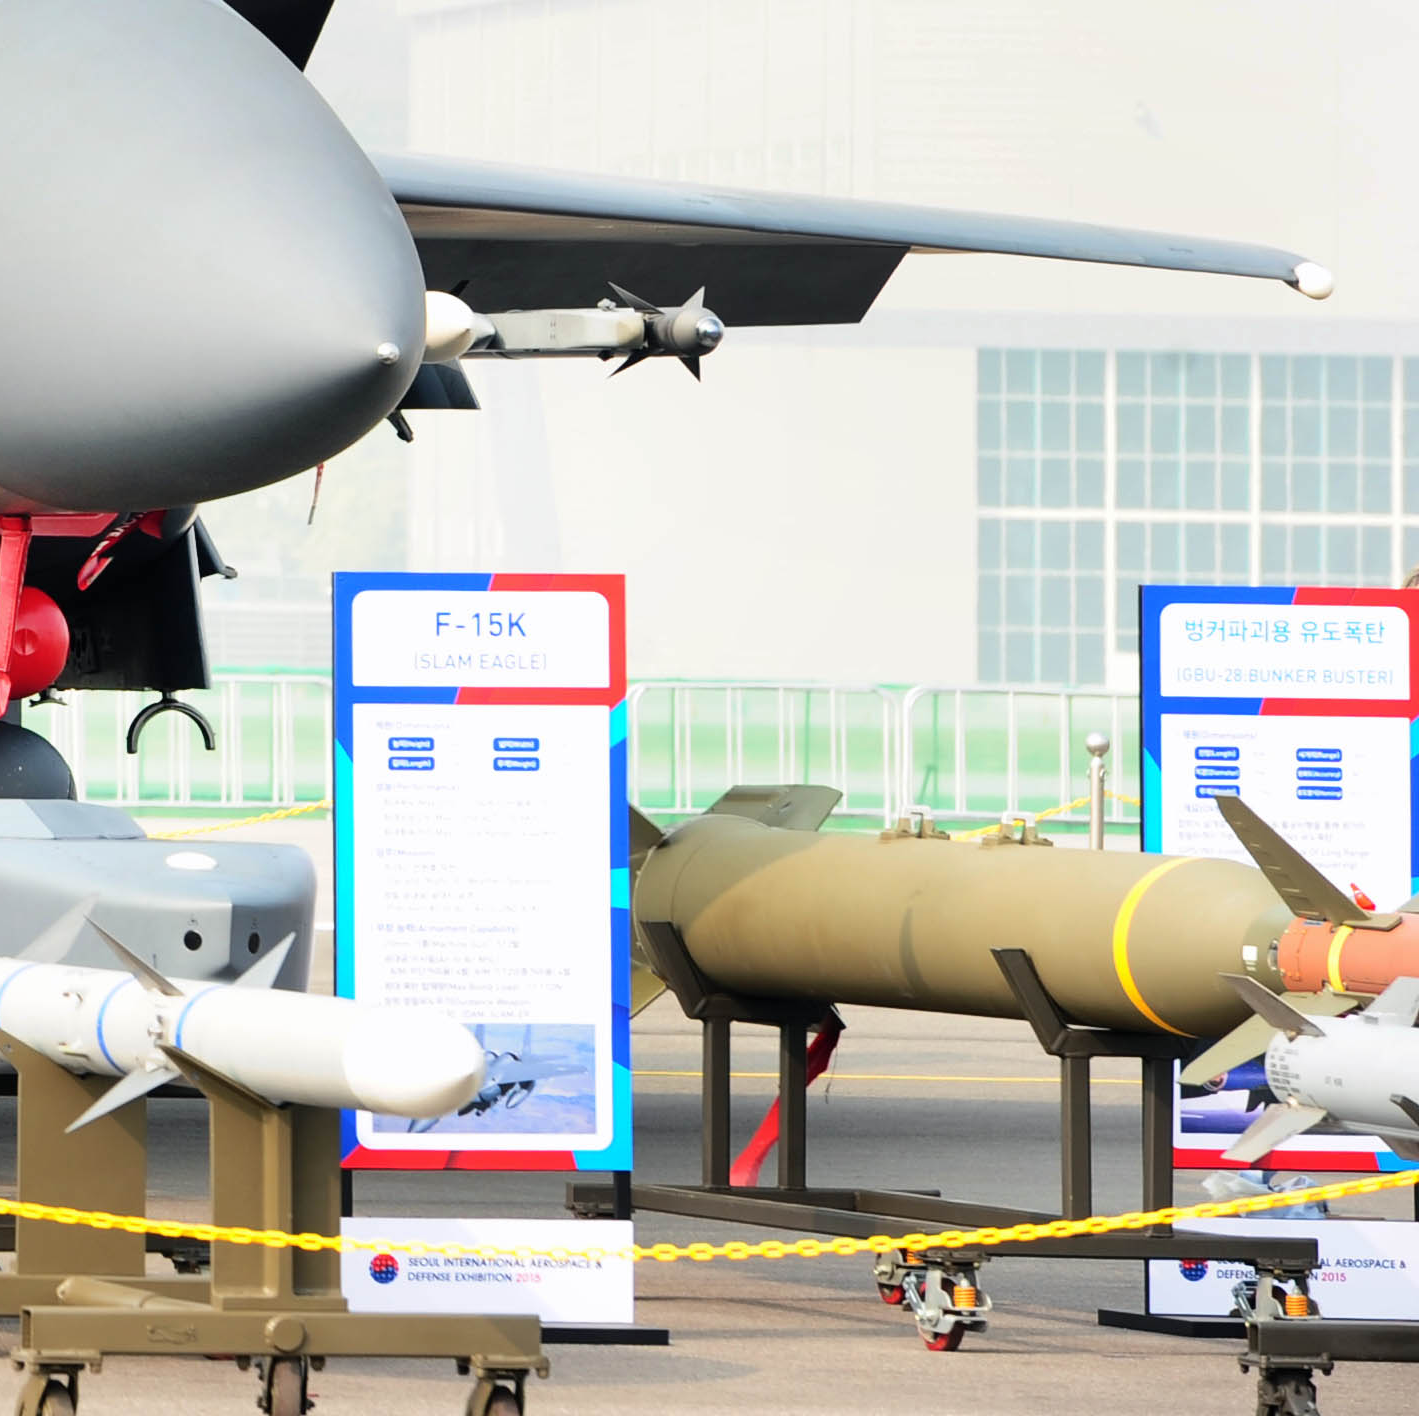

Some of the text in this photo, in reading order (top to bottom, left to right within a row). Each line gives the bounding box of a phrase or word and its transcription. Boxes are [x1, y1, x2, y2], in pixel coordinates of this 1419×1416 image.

[435, 612, 527, 637] F-15K
[1185, 619, 1385, 644] 벙커파괴용 유도폭탄
[414, 653, 548, 672] (SLAM EAGLE)
[408, 1257, 440, 1267] SEOUL
[444, 1257, 525, 1268] INTERNATIONAL
[530, 1259, 591, 1269] AEROSPACE
[1334, 1258, 1406, 1269] AEROSPACE &
[407, 1272, 541, 1283] DEFENSE EXHIBITION 2015
[1216, 1269, 1347, 1282] DEFENS 2015
